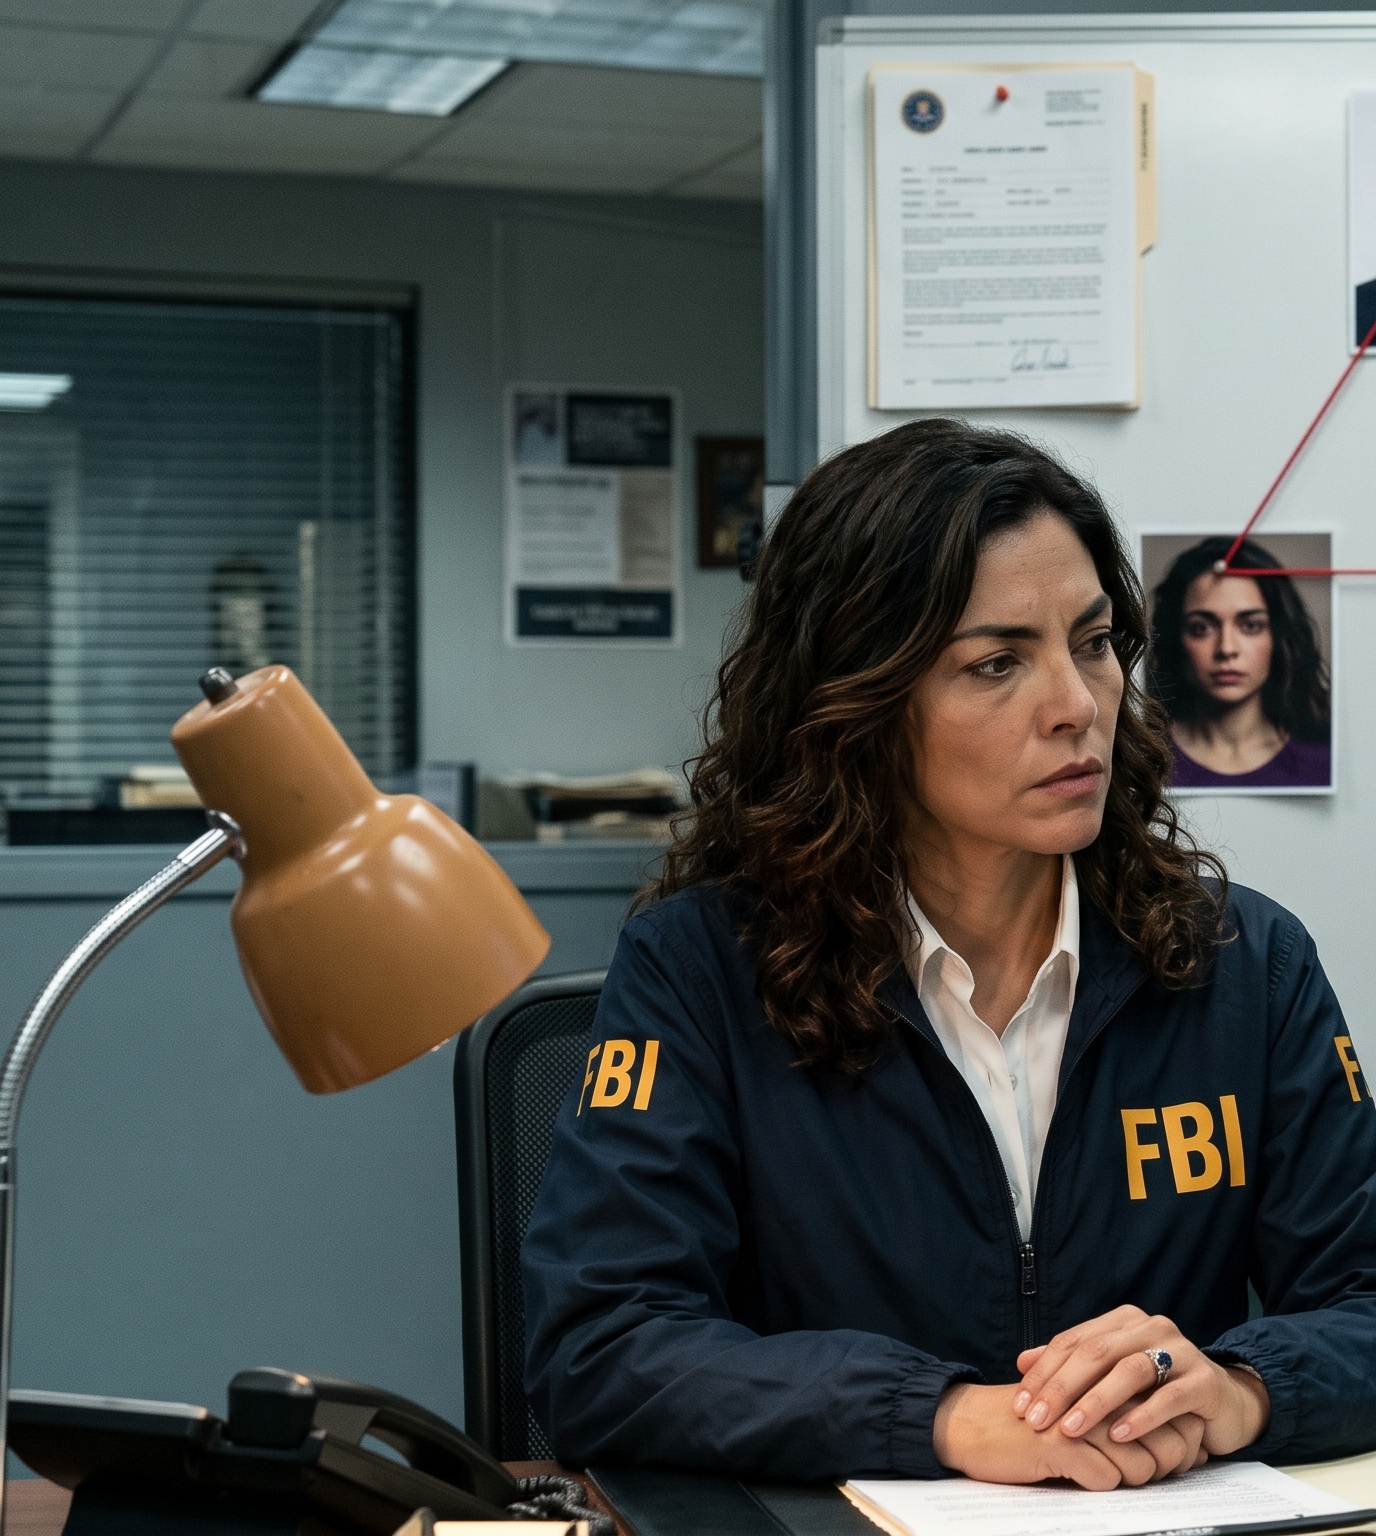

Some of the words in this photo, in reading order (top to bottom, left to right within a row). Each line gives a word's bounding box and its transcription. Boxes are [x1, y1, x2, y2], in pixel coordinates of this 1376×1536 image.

[577, 1039, 660, 1117] FBI
[1334, 1036, 1372, 1102] F
[1120, 1094, 1246, 1200] FBI
